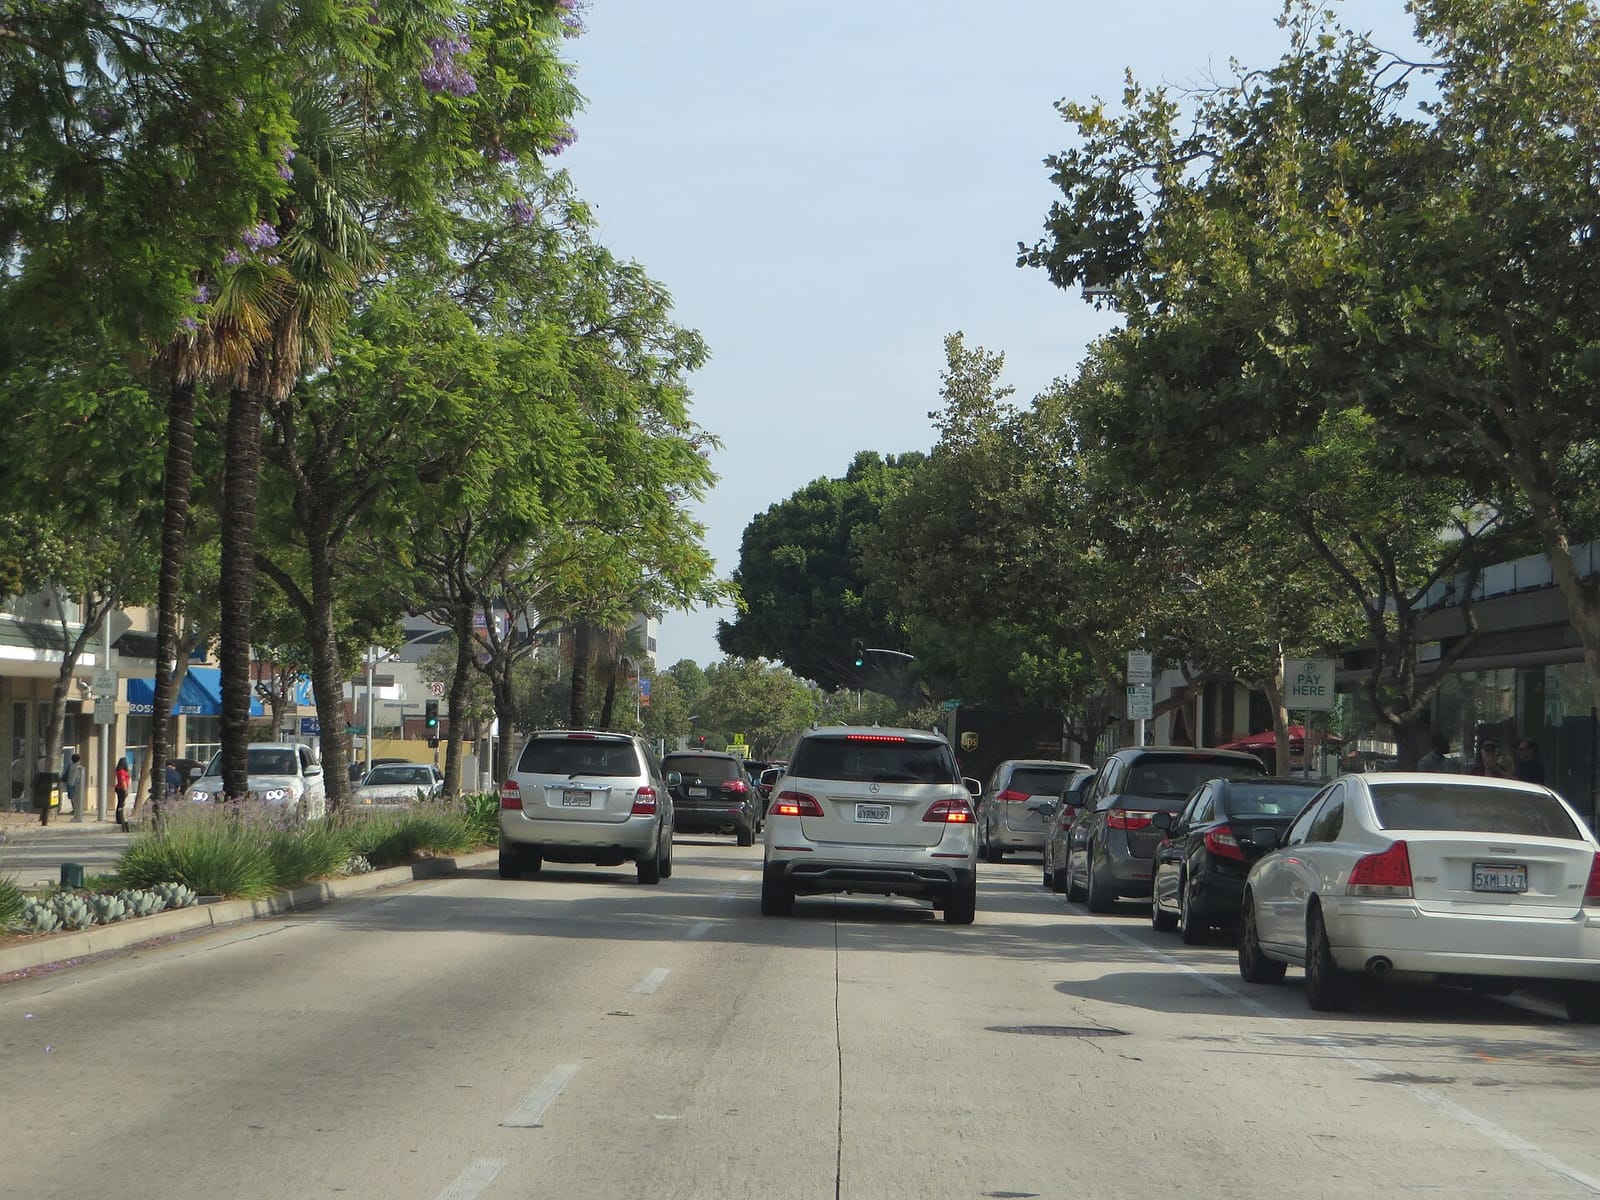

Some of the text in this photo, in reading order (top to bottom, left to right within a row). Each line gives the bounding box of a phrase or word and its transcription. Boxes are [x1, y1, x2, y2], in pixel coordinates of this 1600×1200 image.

[1306, 663, 1313, 671] P
[1297, 674, 1321, 684] PAY
[1292, 685, 1326, 695] HERE
[962, 737, 977, 749] ups
[1475, 873, 1523, 888] 5XML147
